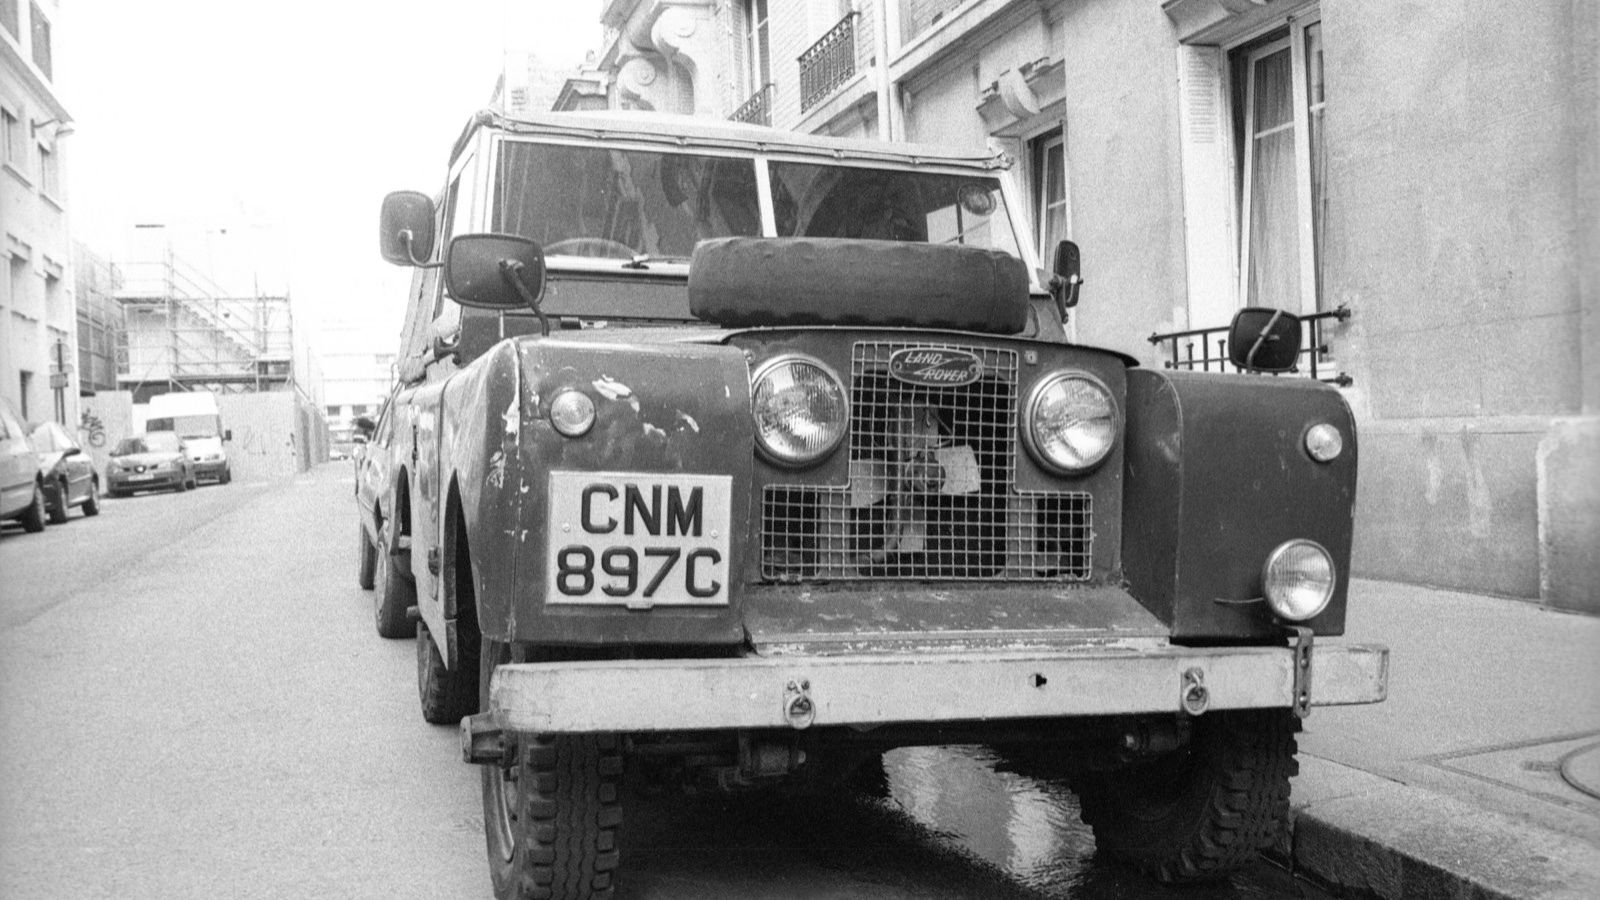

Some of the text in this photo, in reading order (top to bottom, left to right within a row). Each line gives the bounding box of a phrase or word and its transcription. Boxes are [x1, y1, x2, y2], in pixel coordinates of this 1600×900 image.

[904, 351, 943, 365] LAND
[923, 366, 968, 382] ROVER
[581, 483, 703, 537] CNM
[556, 544, 722, 598] 897C
